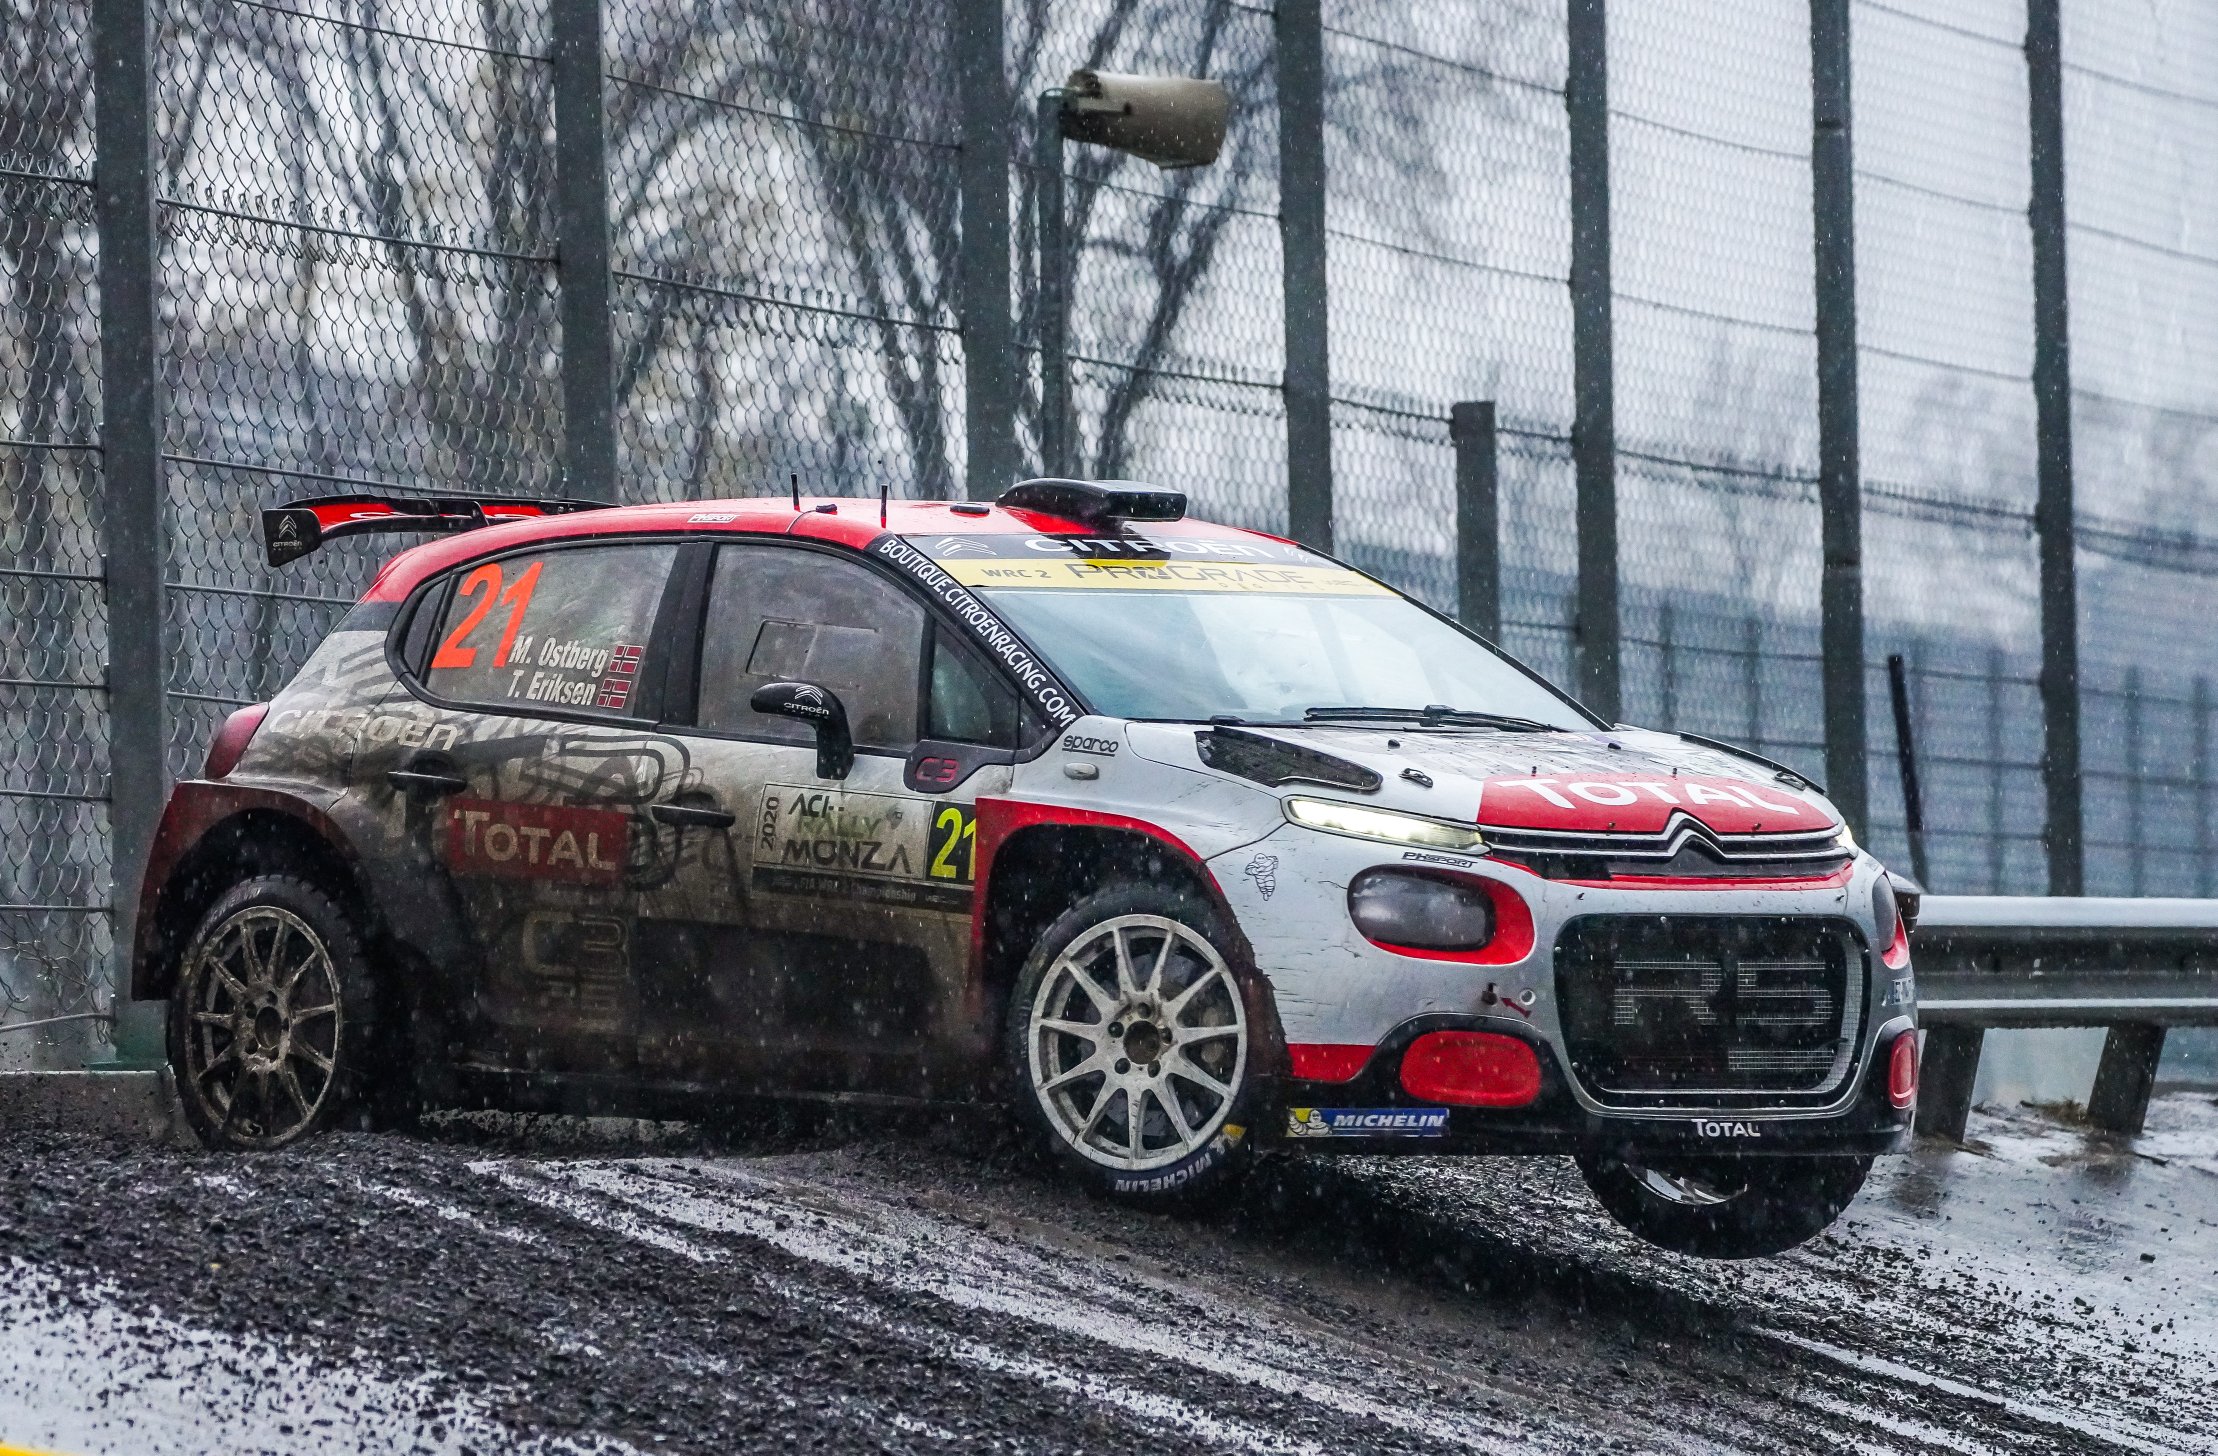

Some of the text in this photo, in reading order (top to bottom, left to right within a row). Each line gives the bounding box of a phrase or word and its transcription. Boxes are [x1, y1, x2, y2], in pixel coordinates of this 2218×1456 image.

[981, 568, 1051, 578] WRC 2
[431, 562, 544, 668] 21
[879, 540, 1076, 727] BOUTIQUE.CITROËNRACING.COM
[509, 635, 609, 678] M. Ostberg
[507, 669, 597, 706] T. Eriksen
[1063, 734, 1119, 753] sparco
[915, 757, 960, 782] C3
[1495, 778, 1799, 815] TOTAL
[453, 809, 616, 871] TOTAL
[760, 796, 780, 851] 2020
[797, 811, 882, 838] RALLY
[781, 839, 912, 874] MONZA
[930, 807, 977, 881] 21
[1333, 1115, 1444, 1127] MICHELIN
[1690, 1119, 1761, 1137] TOTAL
[1114, 1152, 1213, 1193] MICHELIN
